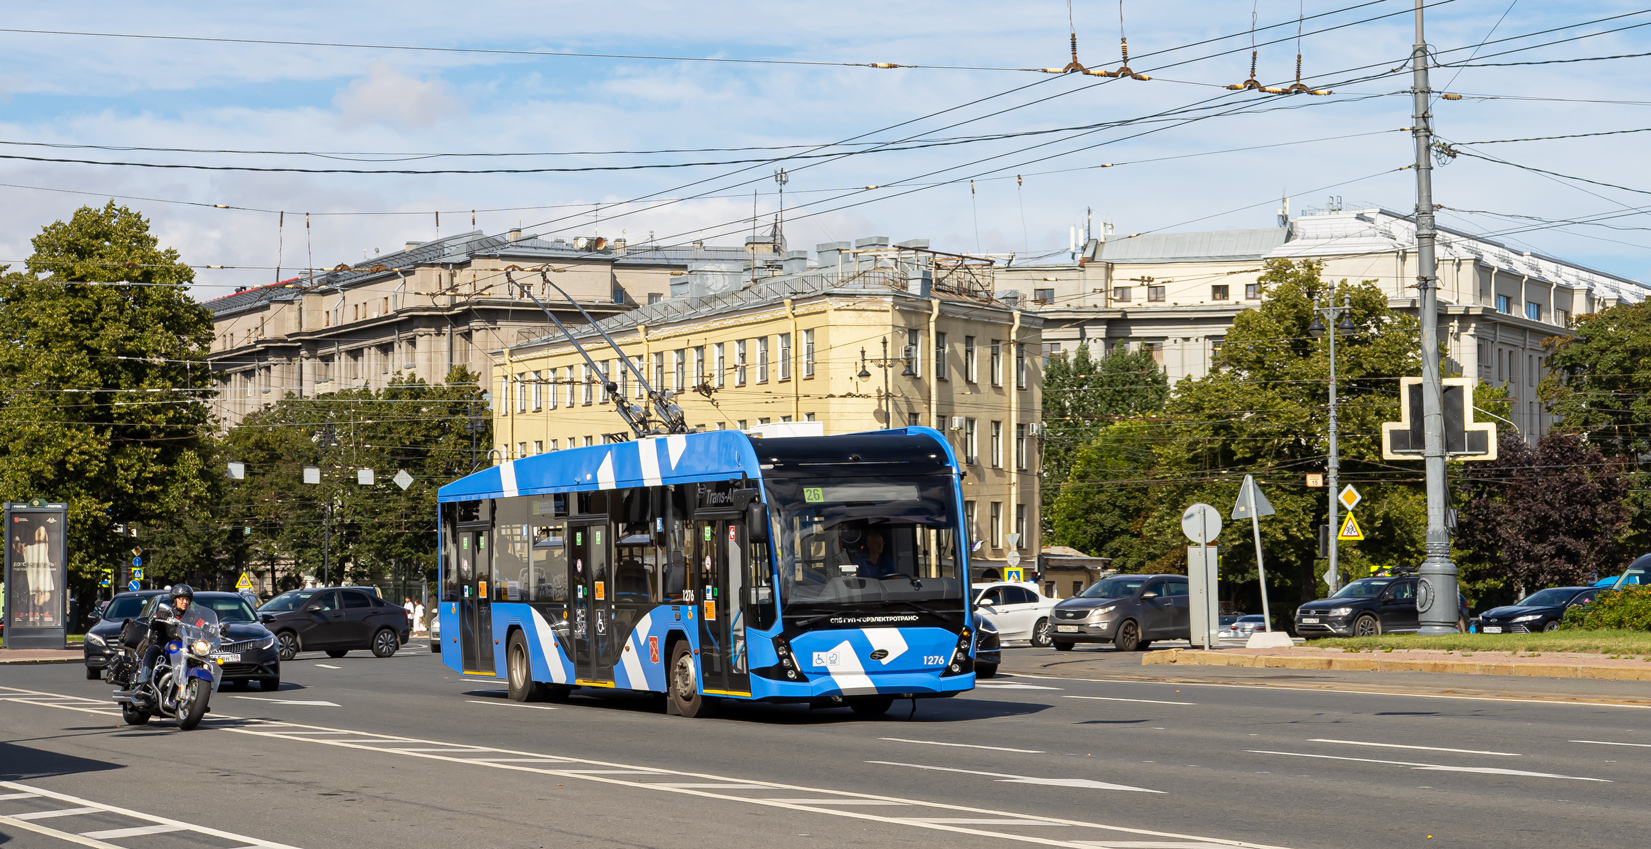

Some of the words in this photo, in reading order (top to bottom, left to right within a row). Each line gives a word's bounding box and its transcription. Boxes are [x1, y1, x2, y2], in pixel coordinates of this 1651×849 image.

[706, 488, 736, 504] Trans-Al
[806, 489, 820, 500] 26
[682, 589, 695, 601] 1276
[923, 655, 945, 665] 1276
